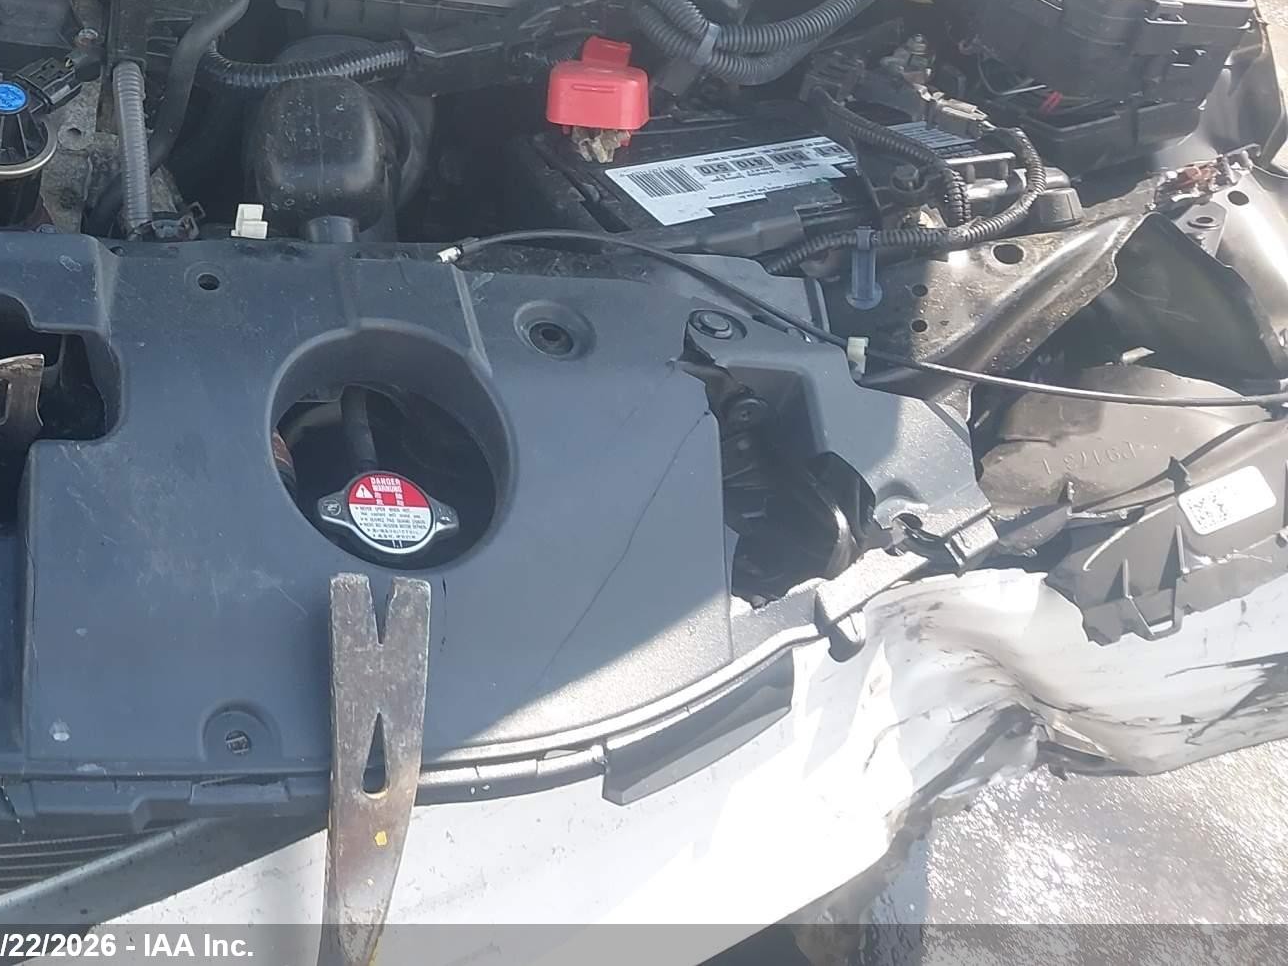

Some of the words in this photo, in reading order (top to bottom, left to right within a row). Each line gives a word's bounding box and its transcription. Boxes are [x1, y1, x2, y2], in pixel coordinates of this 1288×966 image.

[736, 157, 764, 170] 410
[700, 164, 729, 176] 510
[370, 477, 401, 486] DANGER
